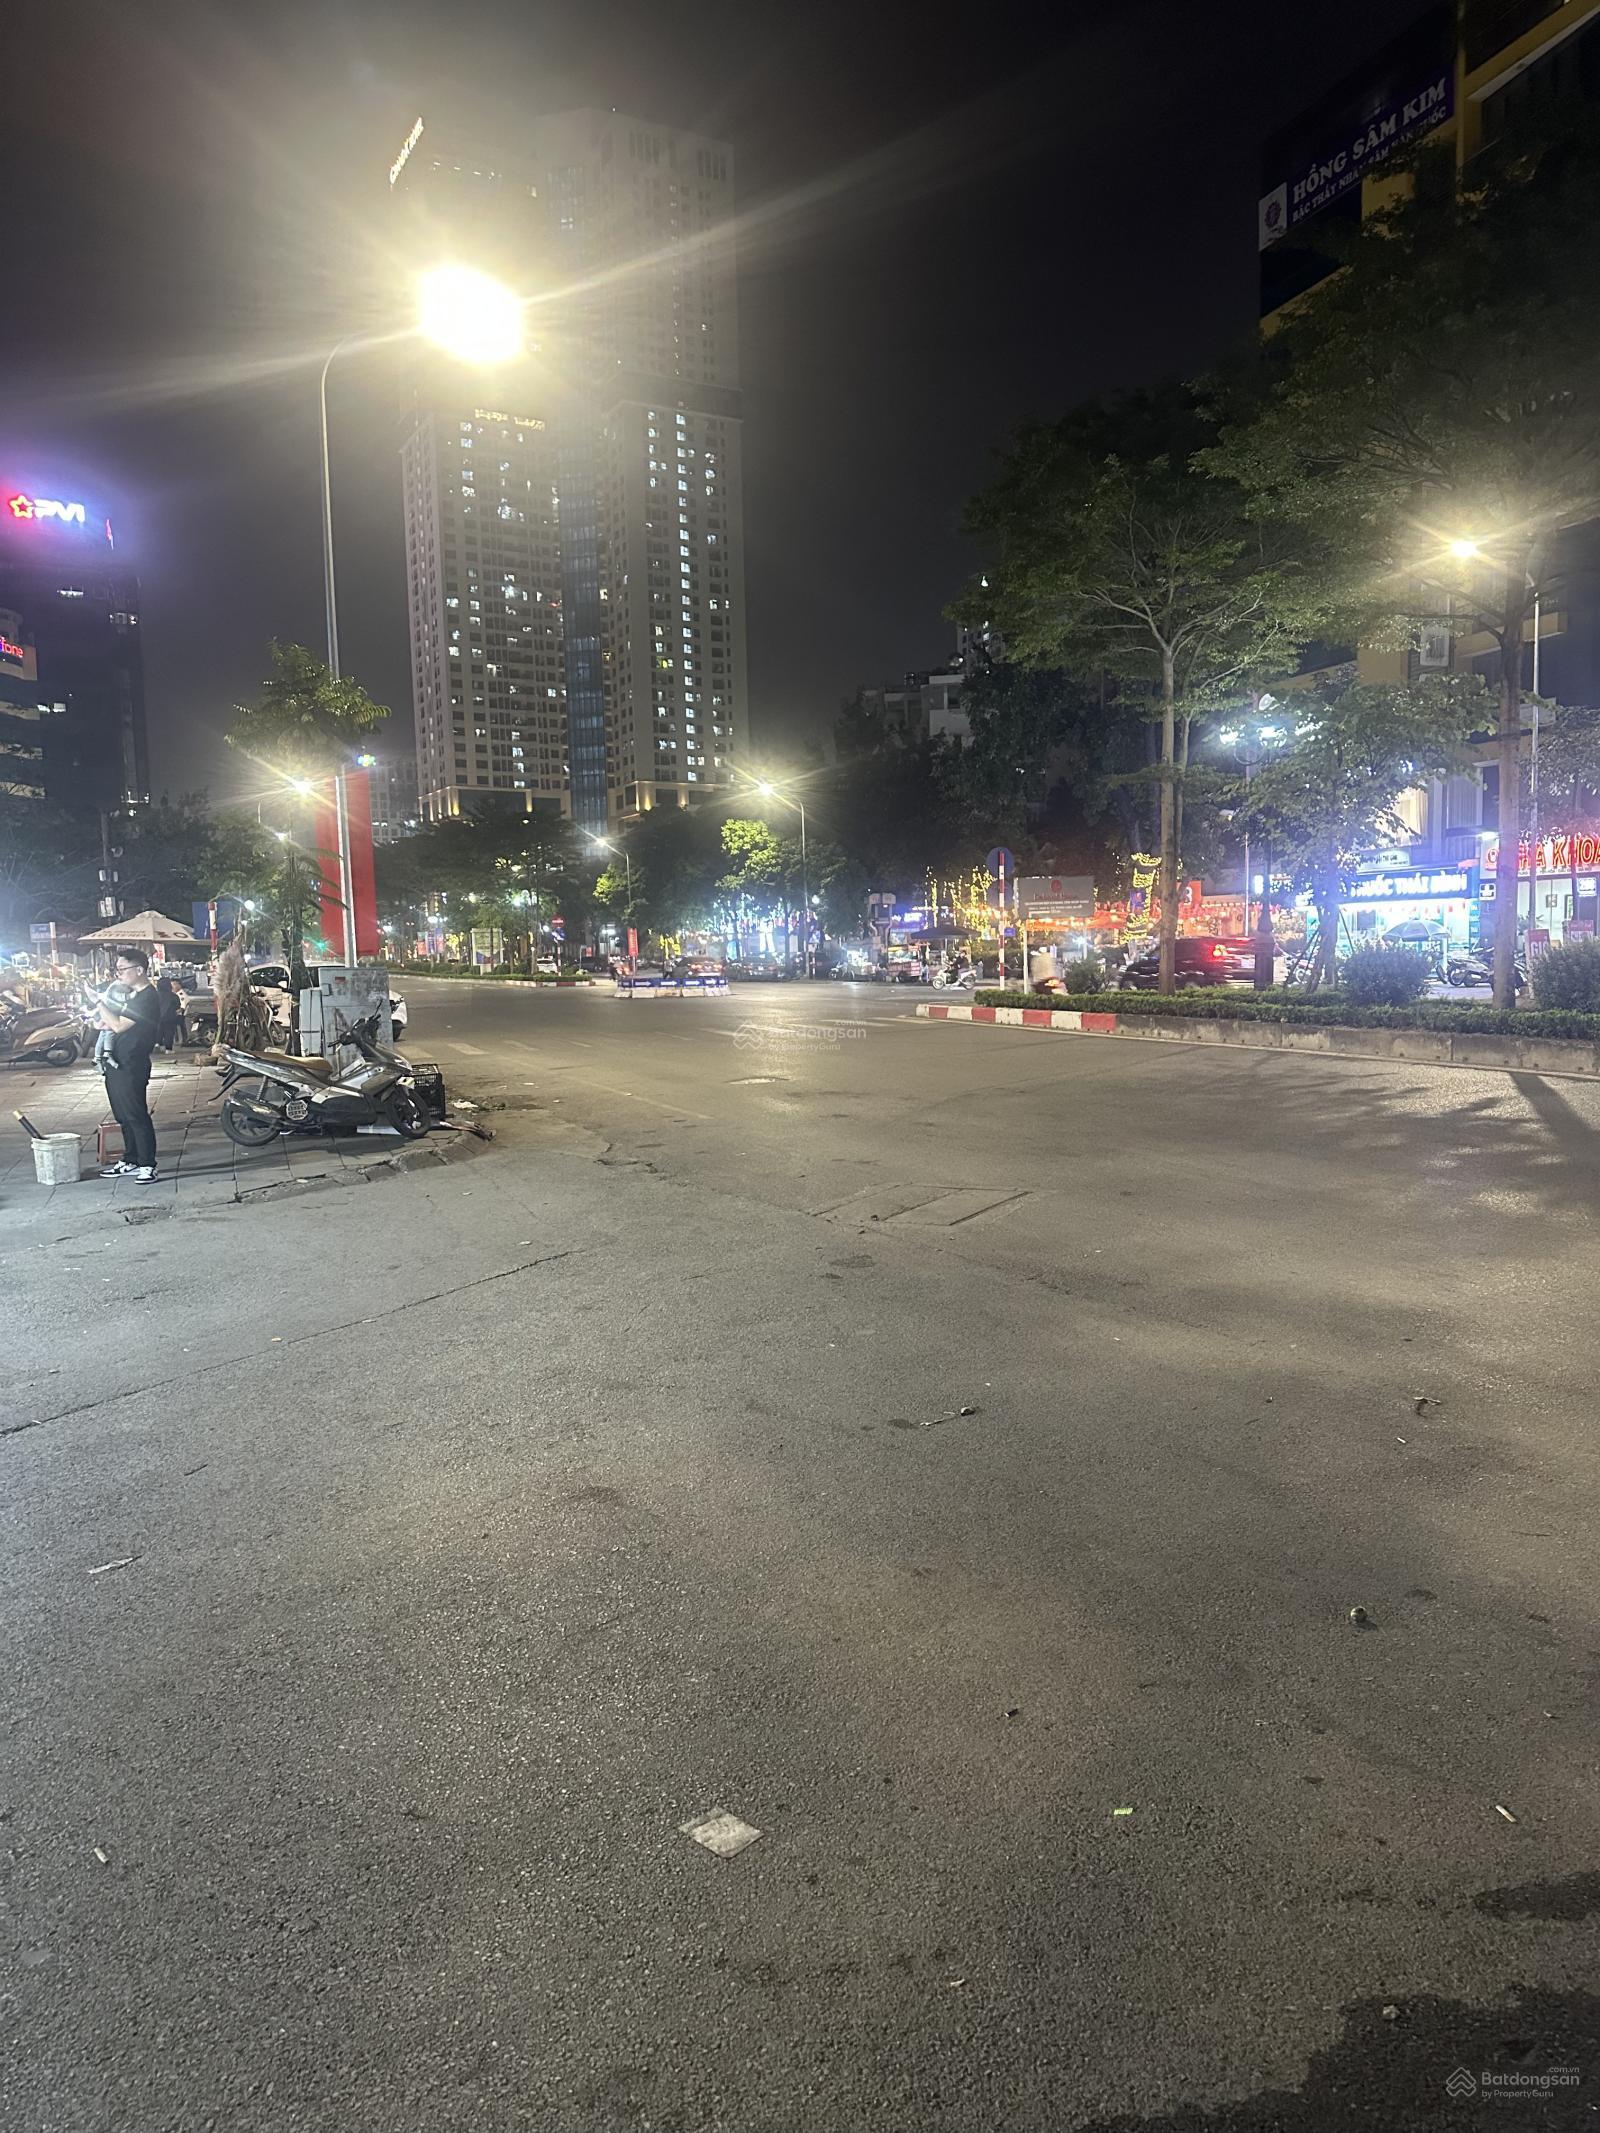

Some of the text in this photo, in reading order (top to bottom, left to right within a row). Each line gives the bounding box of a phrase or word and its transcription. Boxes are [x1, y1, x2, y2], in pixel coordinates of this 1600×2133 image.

[1352, 113, 1398, 161] SÂM
[1402, 77, 1447, 126] KIM
[33, 498, 86, 523] PVI
